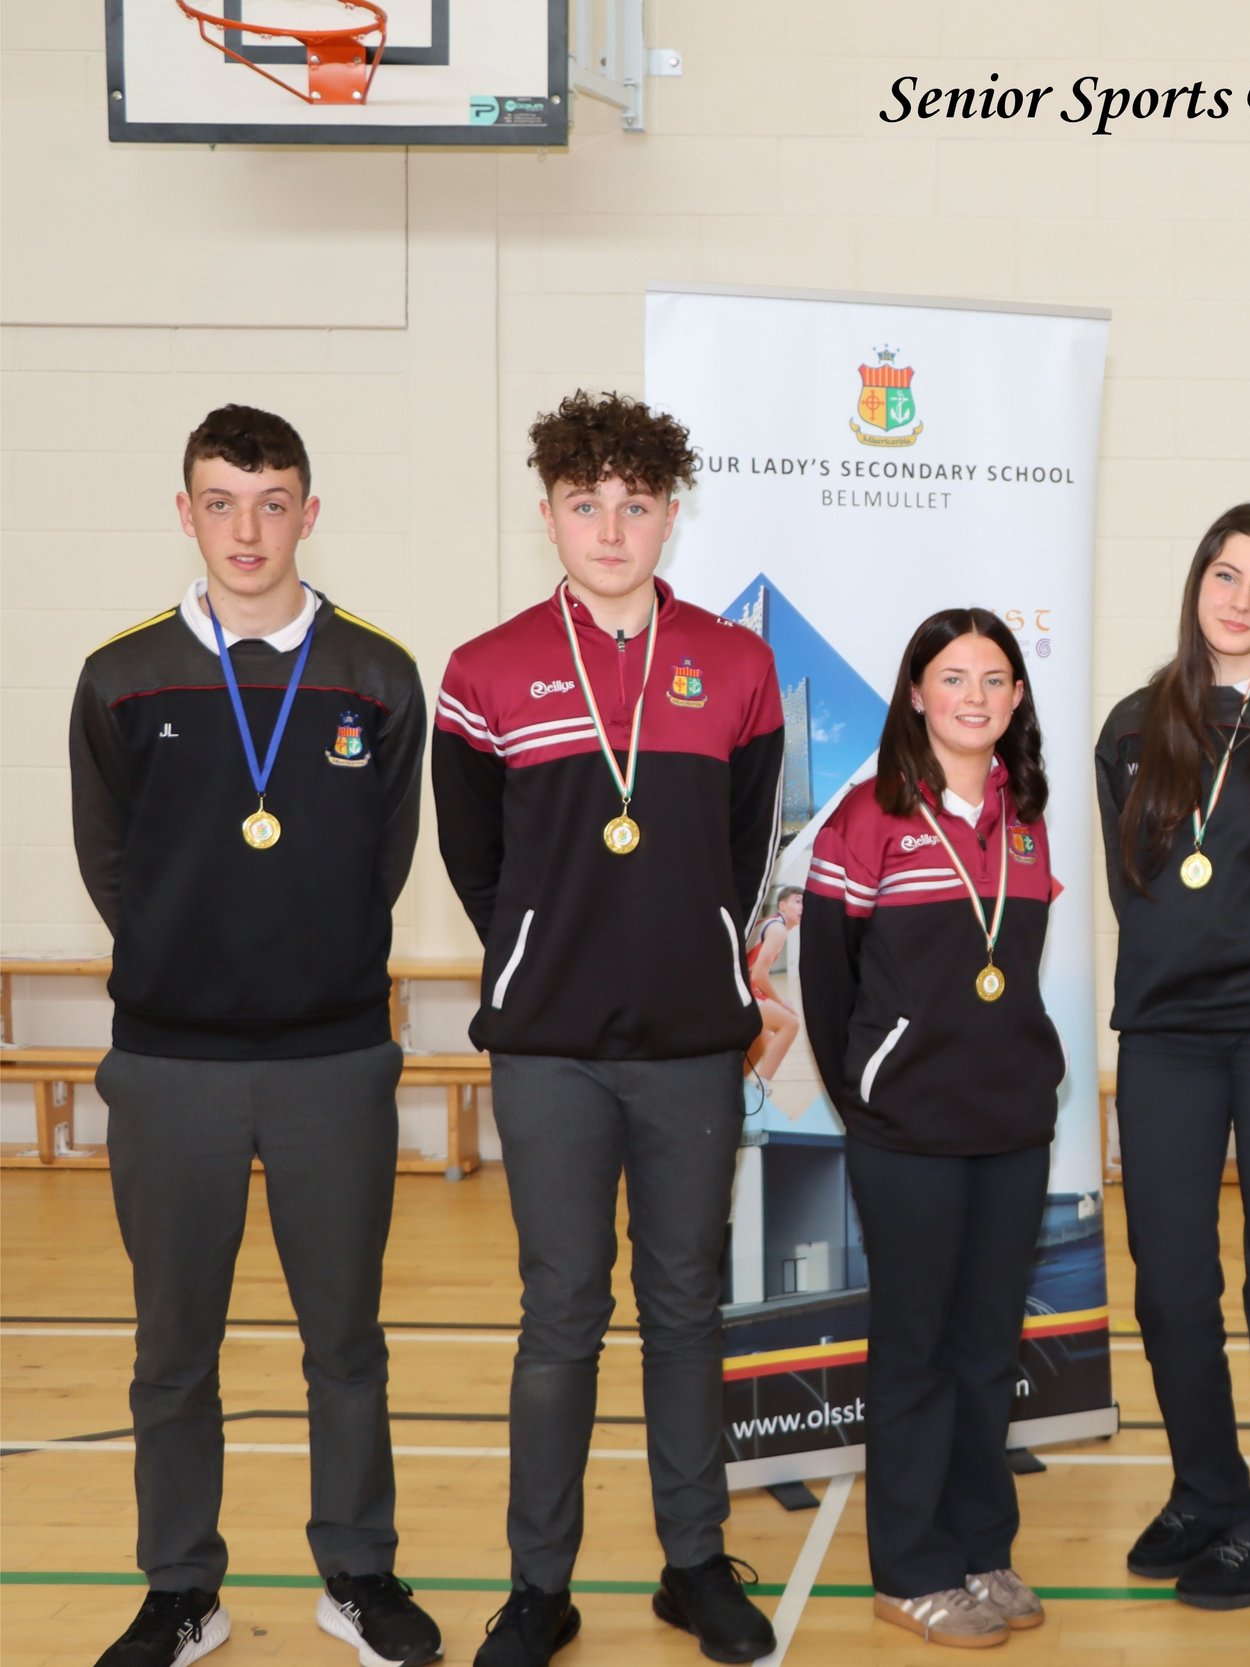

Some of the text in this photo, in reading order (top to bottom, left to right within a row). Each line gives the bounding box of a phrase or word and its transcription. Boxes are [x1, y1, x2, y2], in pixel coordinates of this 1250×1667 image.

[751, 457, 831, 477] LADY’S
[840, 460, 977, 481] SECONDARY
[987, 465, 1075, 484] SCHOOL
[821, 489, 952, 509] BELMULLET
[158, 722, 180, 738] JL
[732, 1397, 866, 1440] www.olssb
